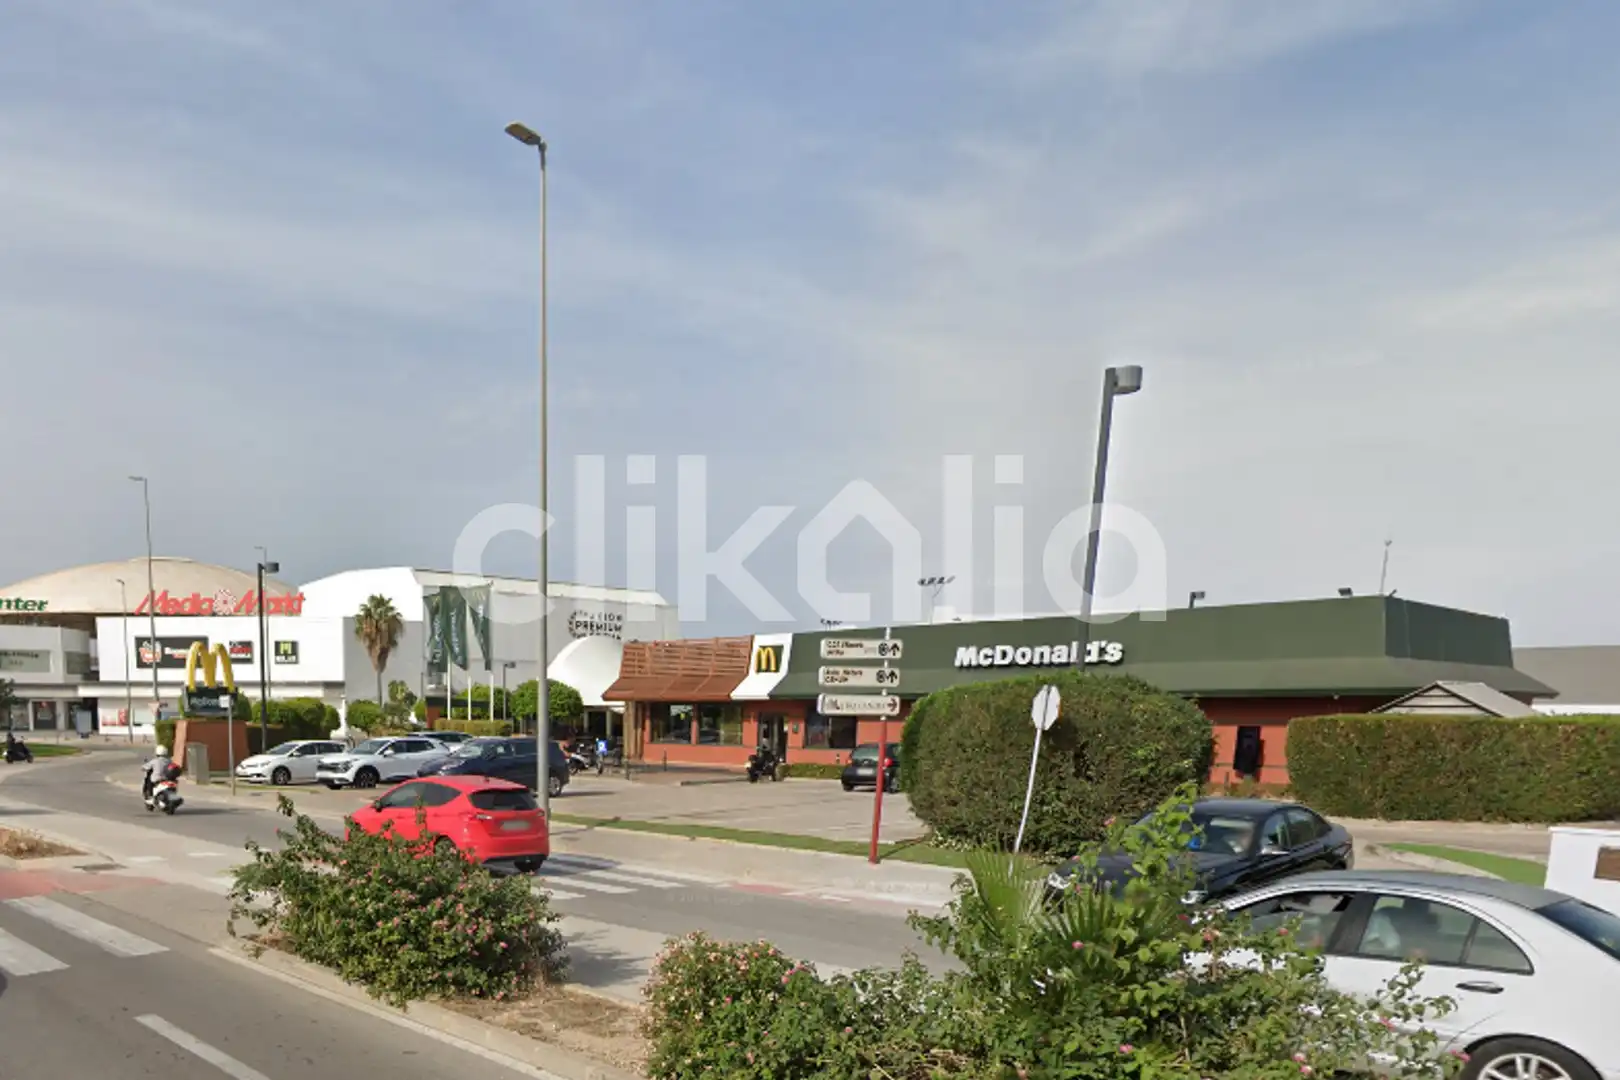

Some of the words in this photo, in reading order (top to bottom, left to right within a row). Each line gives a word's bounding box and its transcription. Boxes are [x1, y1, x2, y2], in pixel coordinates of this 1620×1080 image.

[134, 589, 214, 615] Media
[232, 589, 304, 616] Markt
[954, 640, 1124, 667] McDonald's
